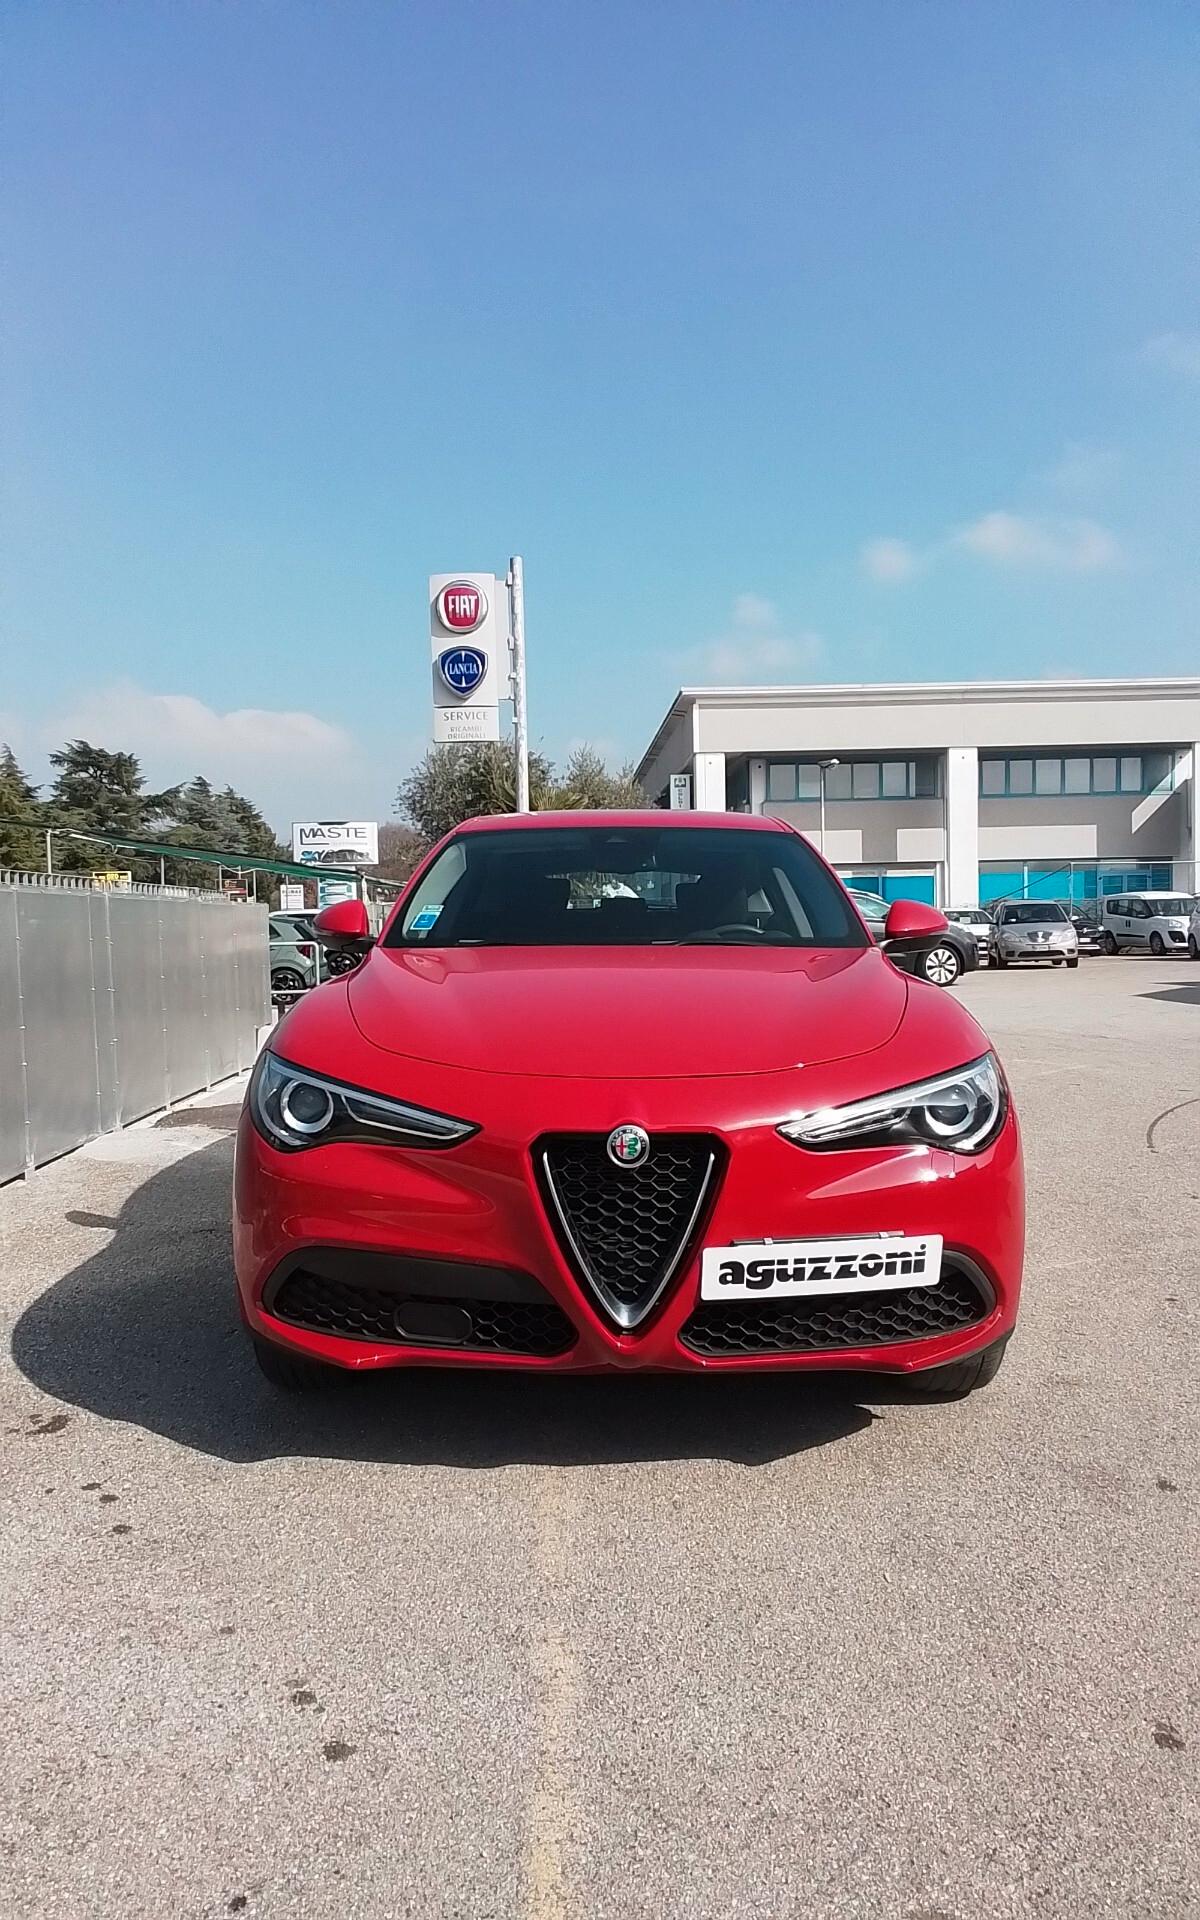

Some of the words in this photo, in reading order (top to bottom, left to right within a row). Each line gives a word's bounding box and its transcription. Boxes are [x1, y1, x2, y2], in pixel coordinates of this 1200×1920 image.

[447, 595, 478, 618] FIAT
[449, 662, 478, 675] LANCIA
[443, 711, 489, 721] SERVICE
[718, 1243, 927, 1290] aguzzoni
